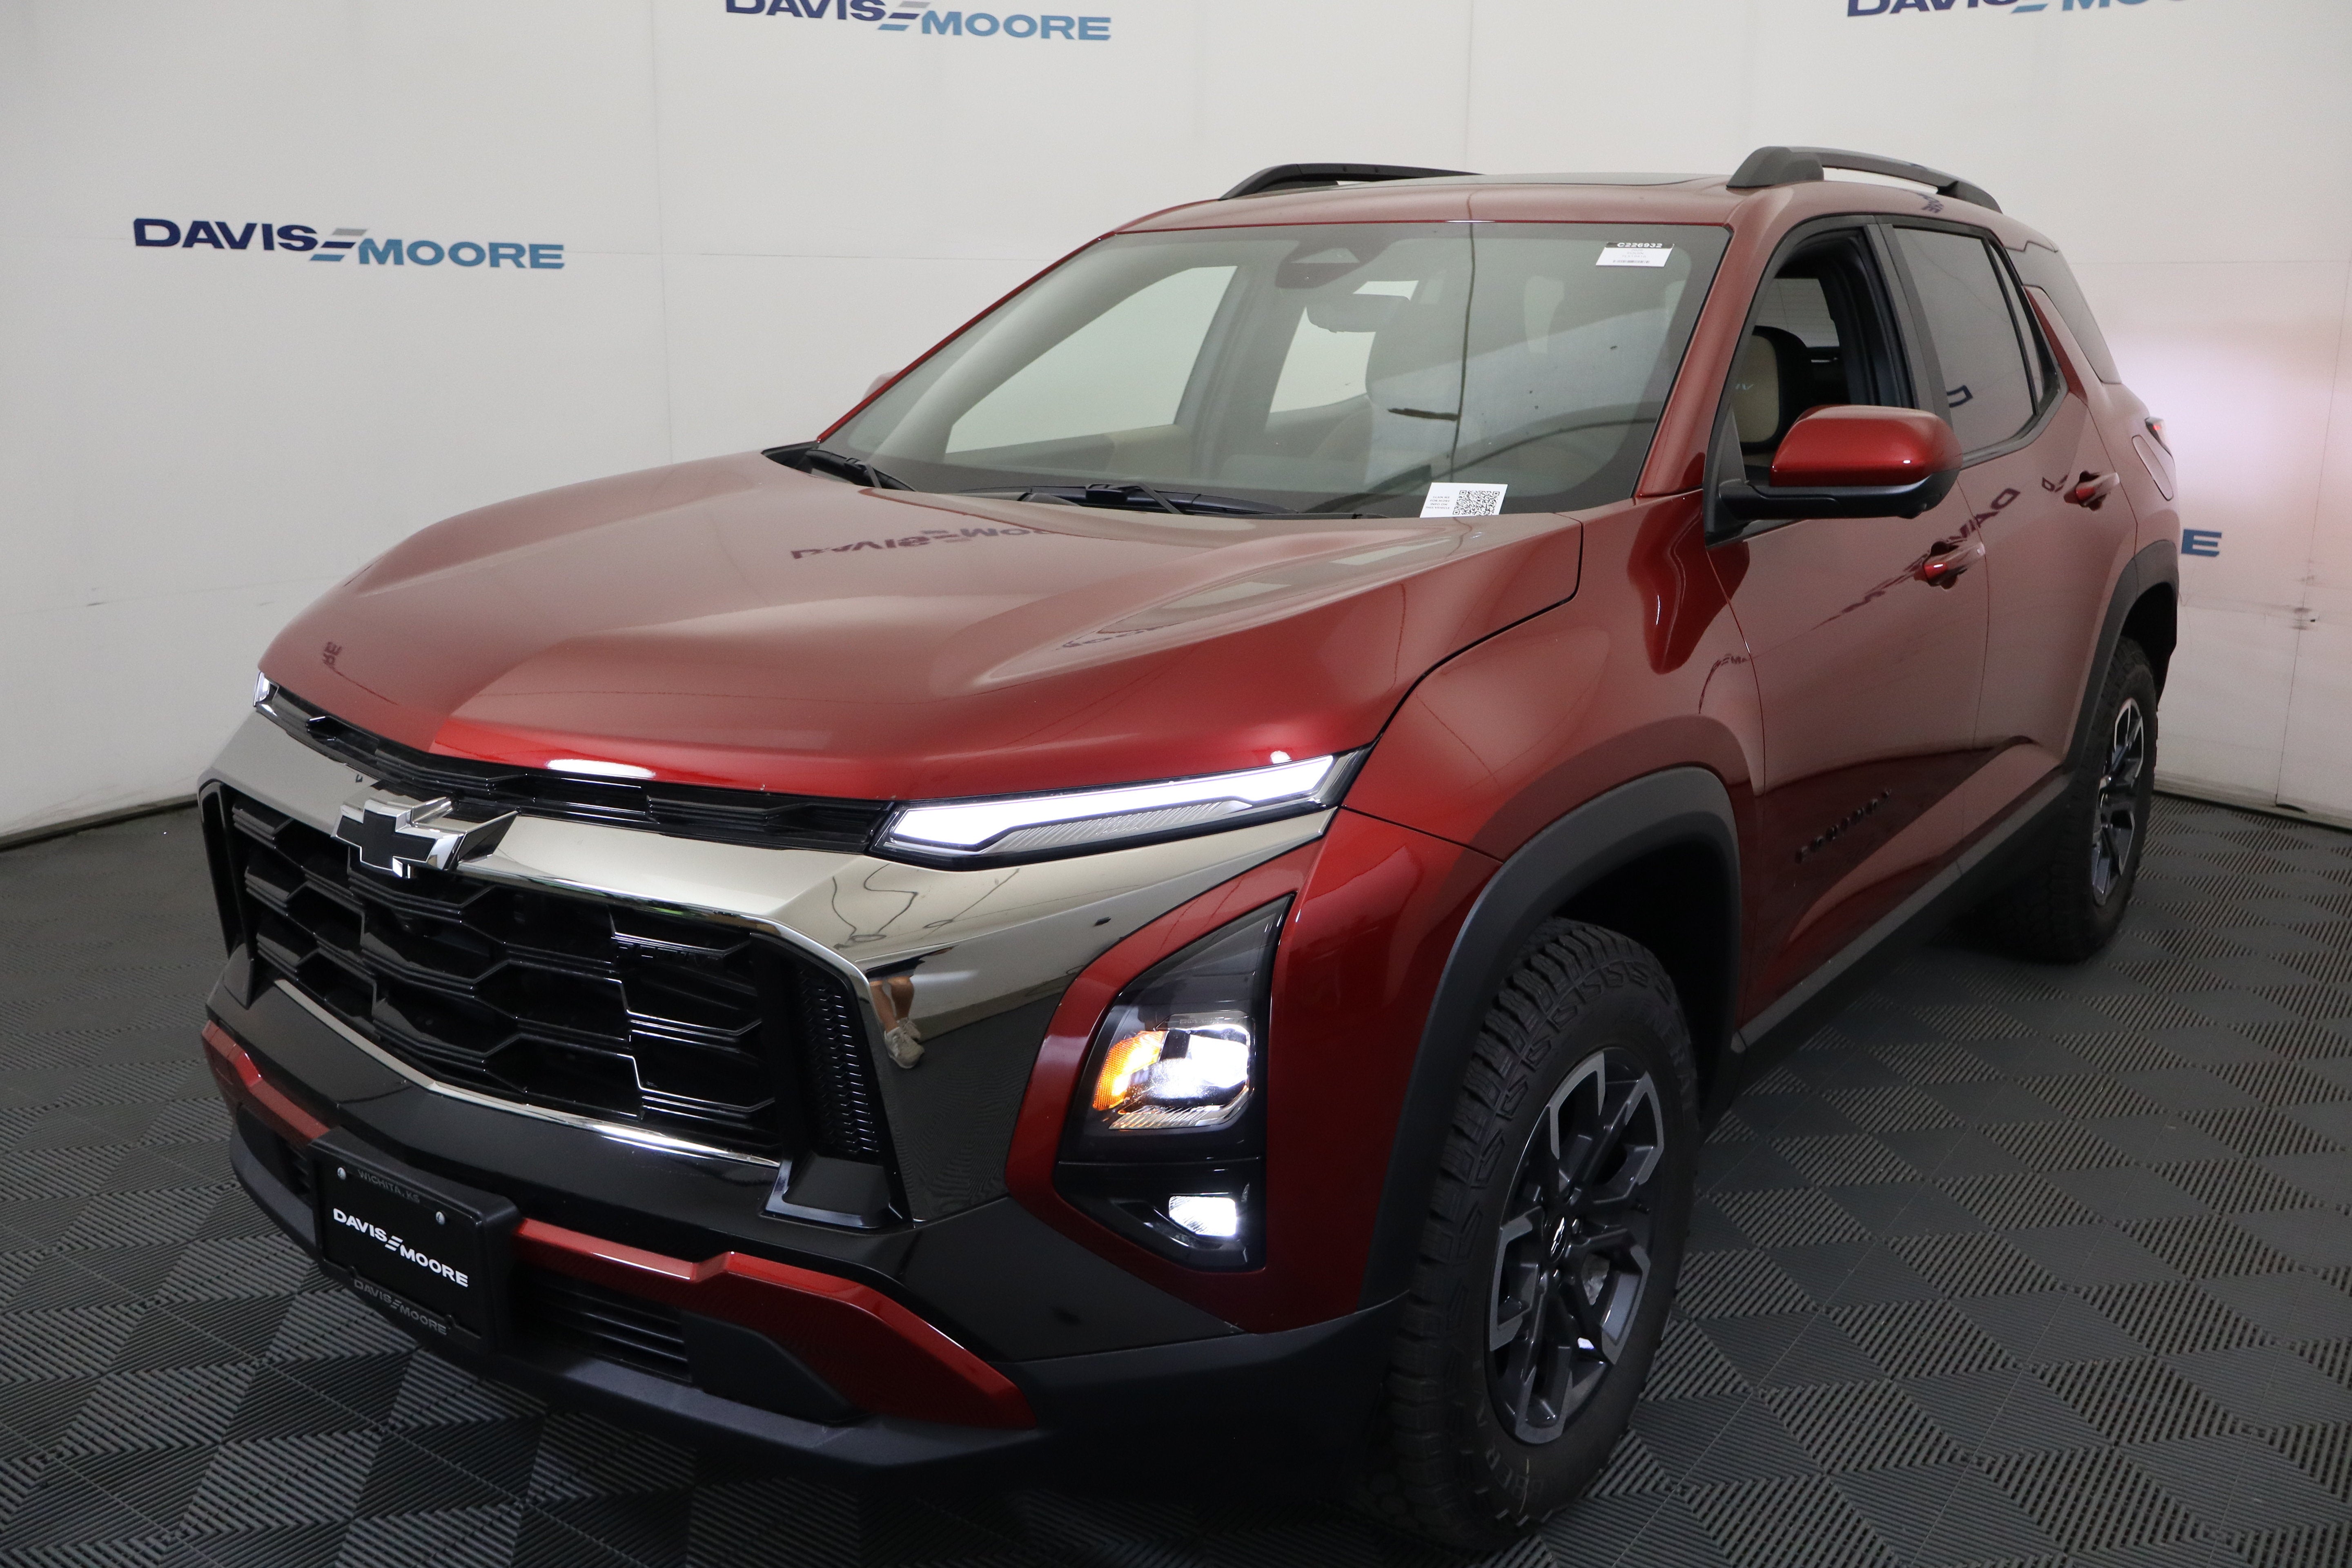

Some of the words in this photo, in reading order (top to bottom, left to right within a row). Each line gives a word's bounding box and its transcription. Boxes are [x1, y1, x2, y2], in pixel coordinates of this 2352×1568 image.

[921, 10, 1111, 41] MOORE
[133, 218, 317, 251] DAVIS
[359, 238, 565, 270] MOORE
[333, 1208, 388, 1243] DAVIS
[399, 1244, 468, 1287] MOORE
[354, 1279, 392, 1303] DAVIS
[400, 1305, 447, 1335] MOORE
